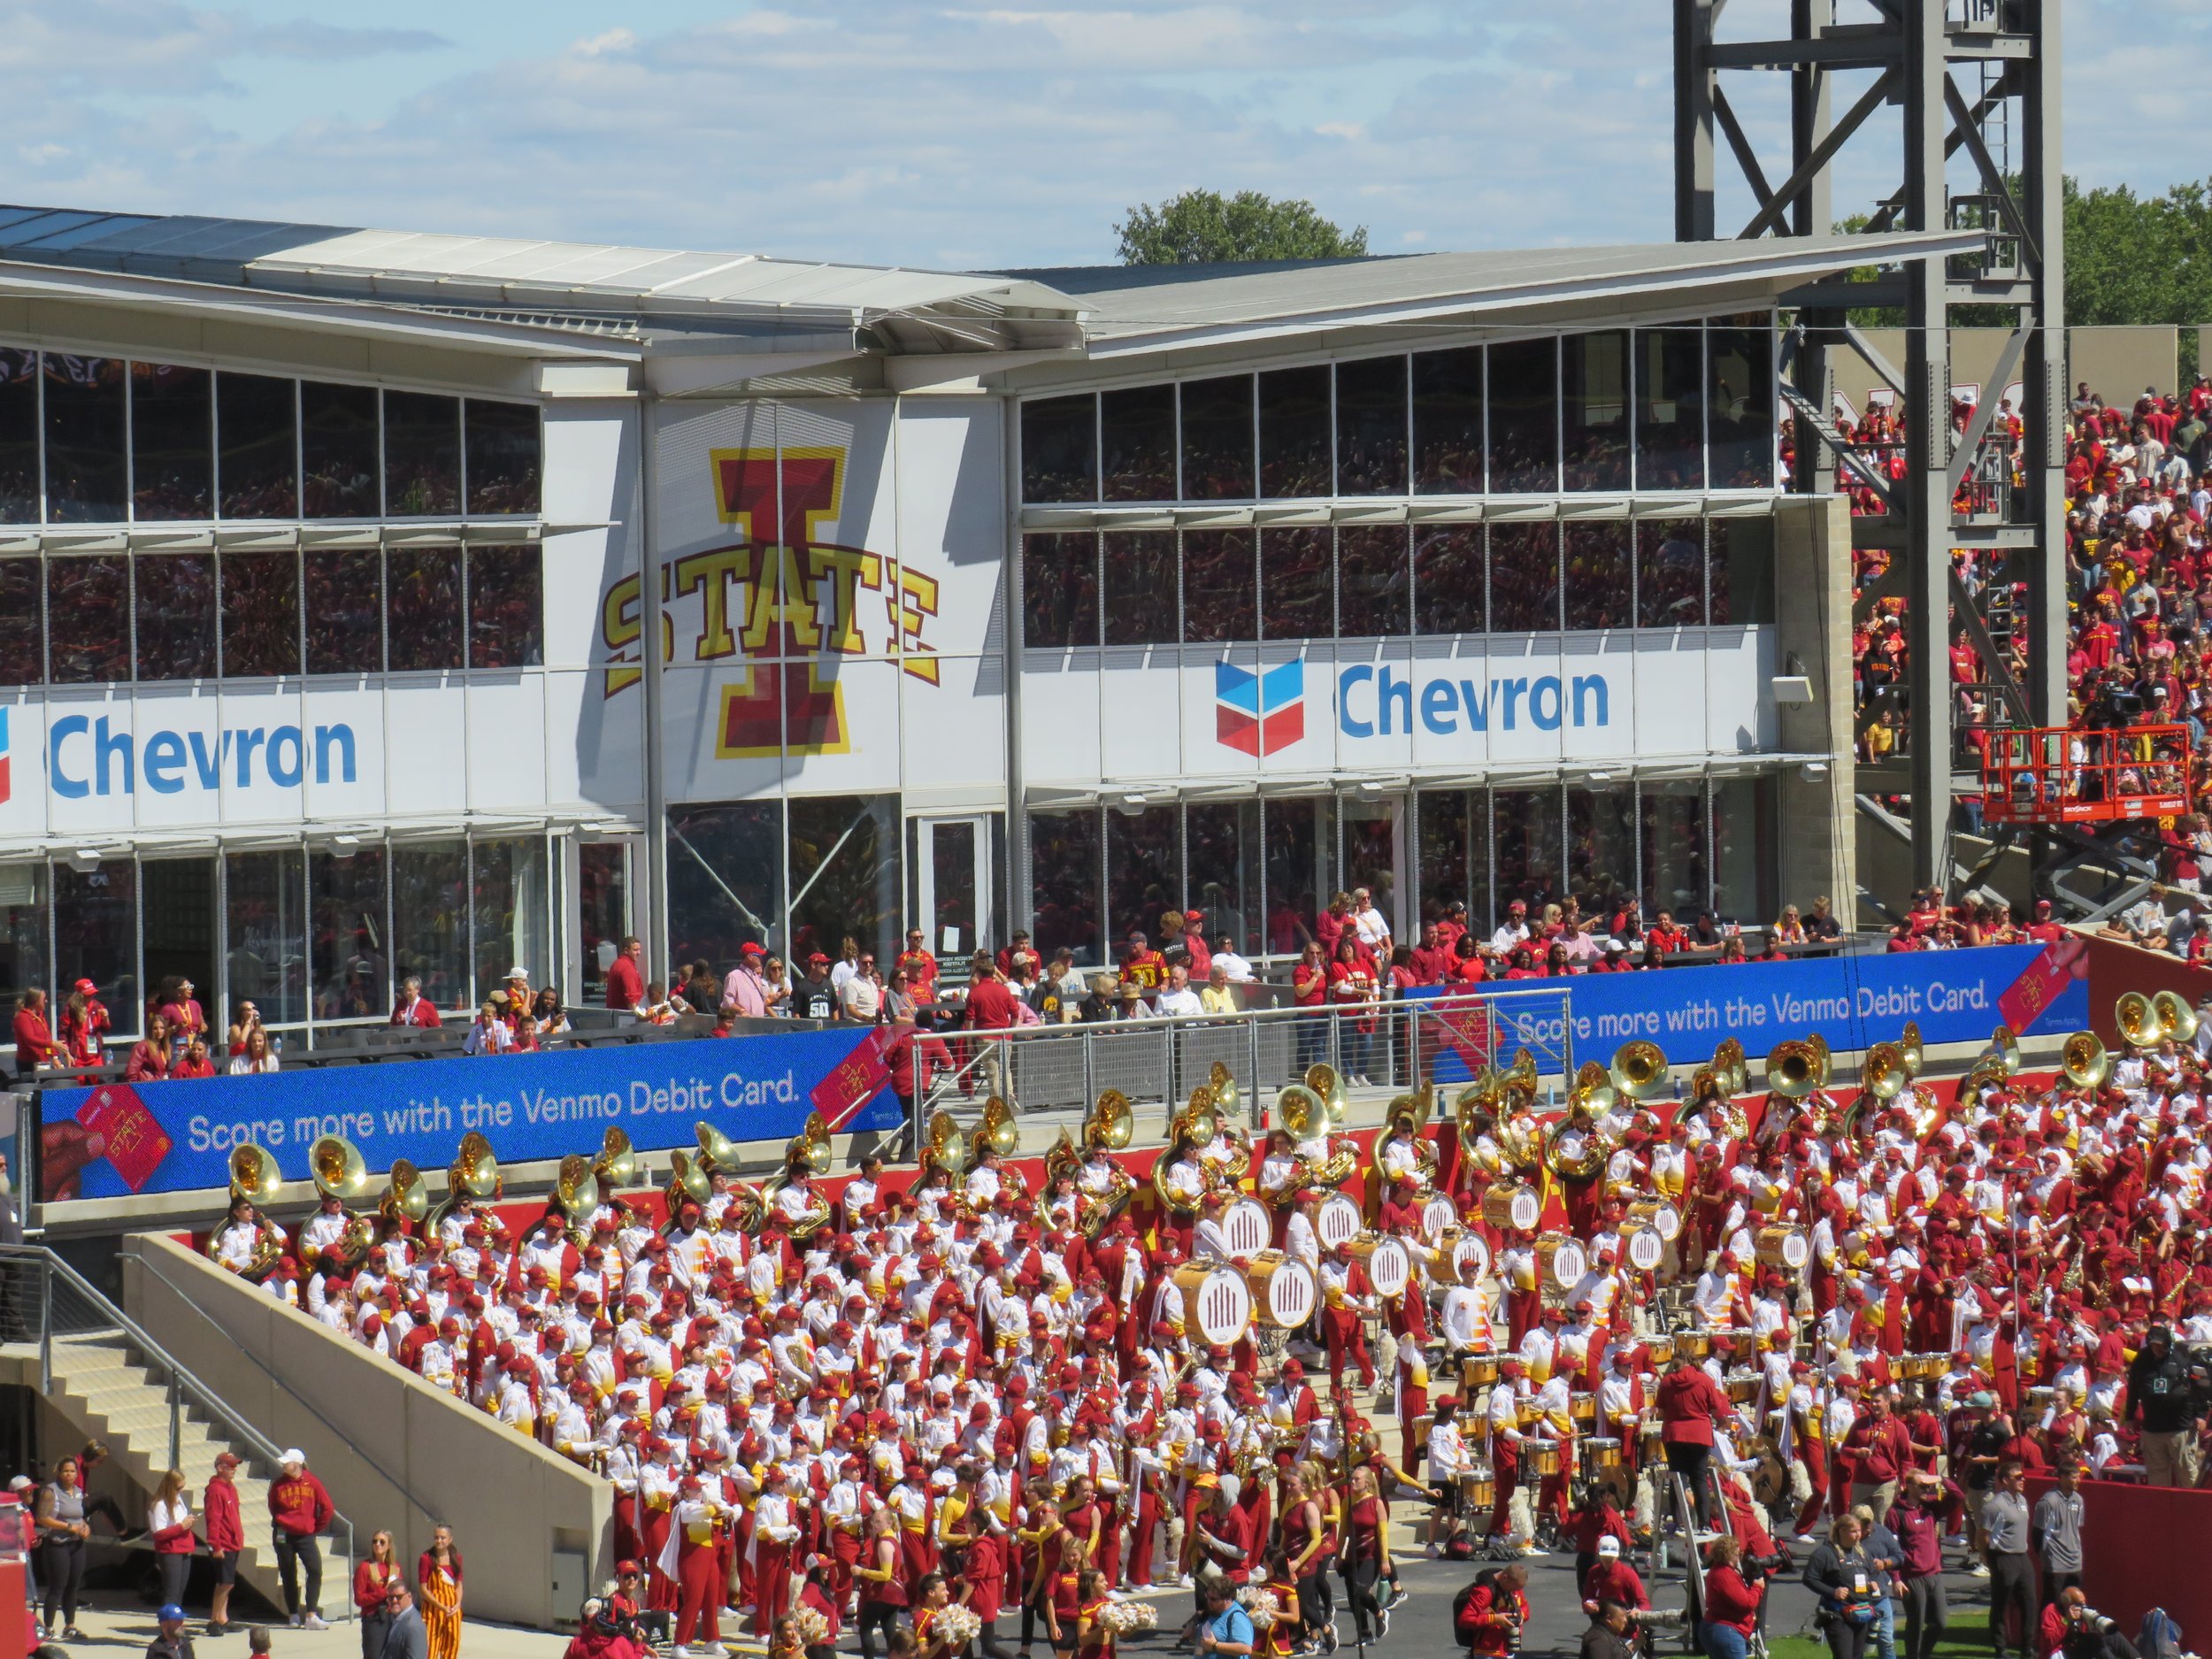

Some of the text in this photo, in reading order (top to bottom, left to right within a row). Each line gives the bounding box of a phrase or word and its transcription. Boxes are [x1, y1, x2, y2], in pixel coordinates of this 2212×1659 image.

[603, 541, 941, 701] STATE
[1333, 664, 1609, 738] Chevron
[43, 714, 356, 799] Chevron
[2063, 804, 2093, 813] SKYJACK
[810, 1002, 829, 1018] 50
[1598, 1008, 1661, 1038] more
[1666, 1000, 1719, 1032] with
[1724, 996, 1767, 1027] the
[1772, 992, 1850, 1023] Venmo
[1856, 985, 1921, 1018] Debit
[1926, 979, 1989, 1012] Card.
[188, 1069, 800, 1152] Score more with the Venmo Debit Card.
